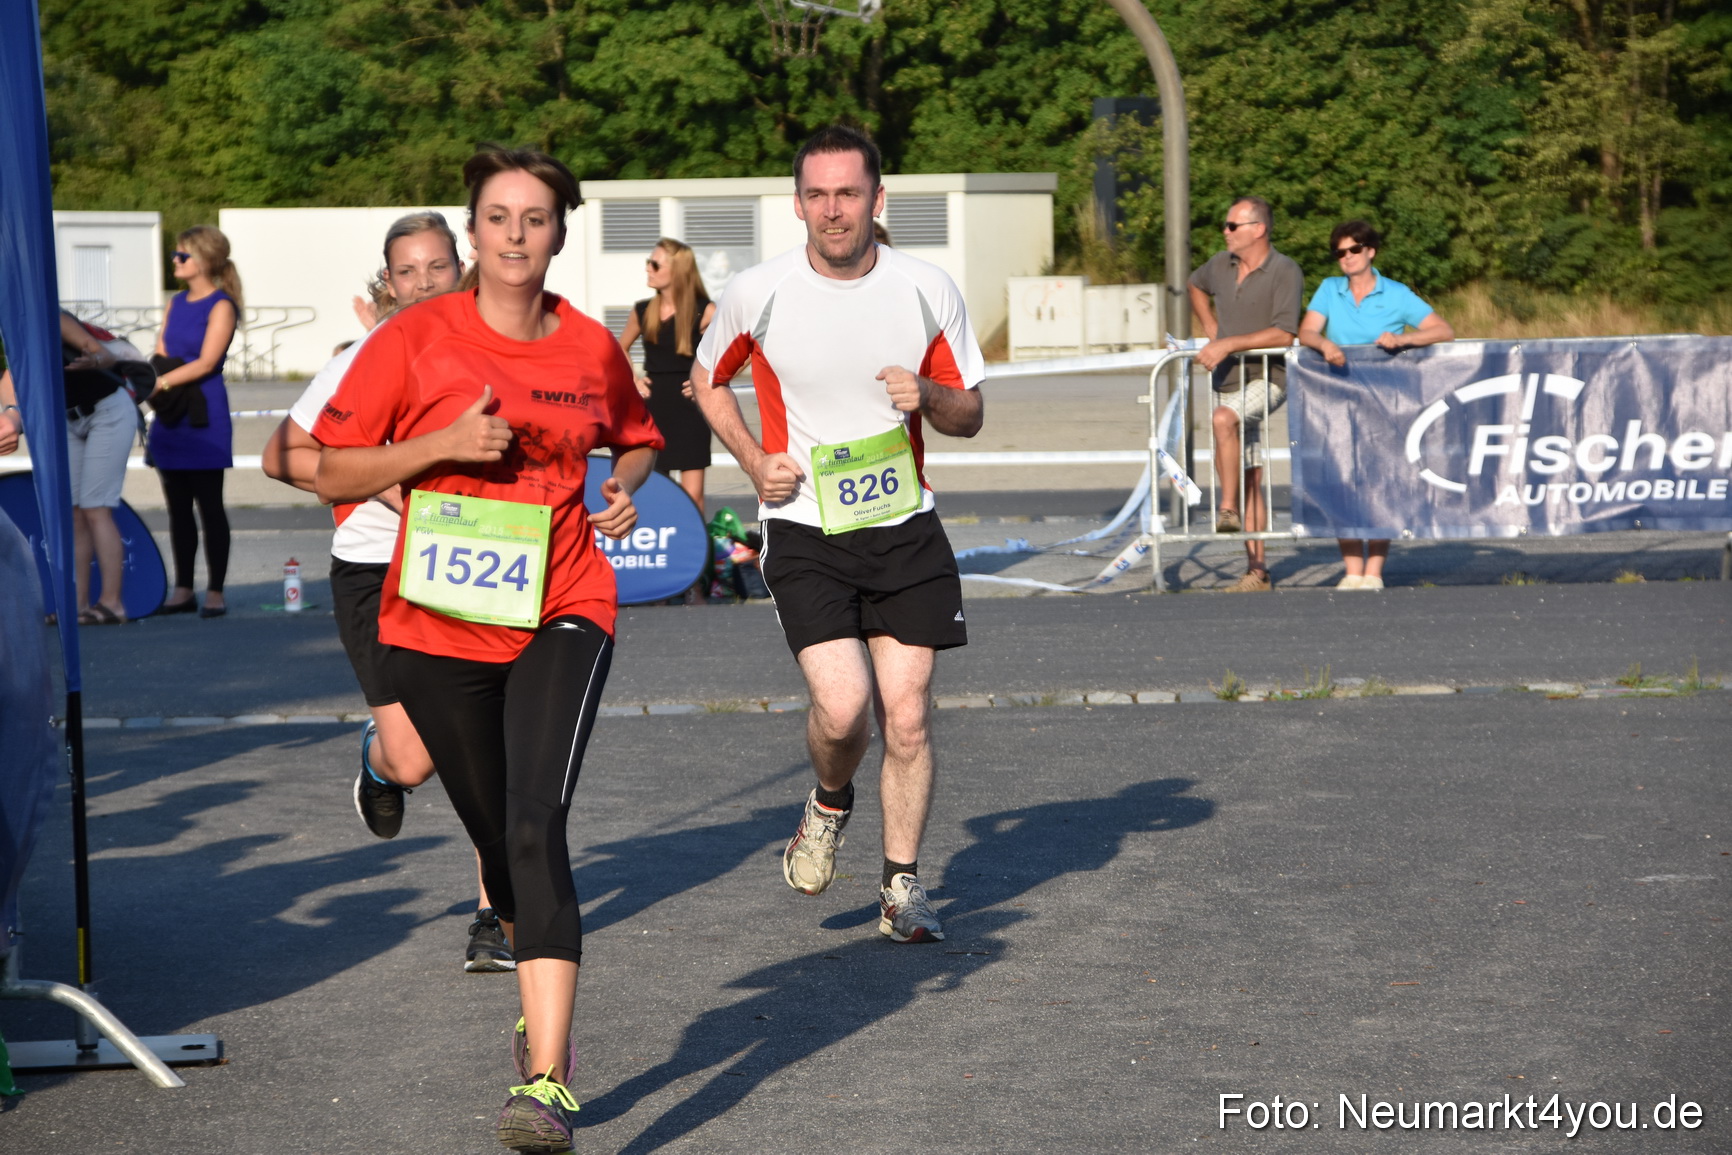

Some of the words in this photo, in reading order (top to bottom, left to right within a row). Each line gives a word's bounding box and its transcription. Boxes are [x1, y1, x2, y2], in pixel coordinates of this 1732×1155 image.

[531, 390, 577, 404] swn
[838, 467, 899, 506] 826
[1494, 478, 1729, 507] AUTOMOBILE
[872, 503, 891, 512] Fuchs
[430, 514, 478, 527] firmenlauf
[419, 543, 530, 592] 1524
[606, 555, 667, 569] OBILE
